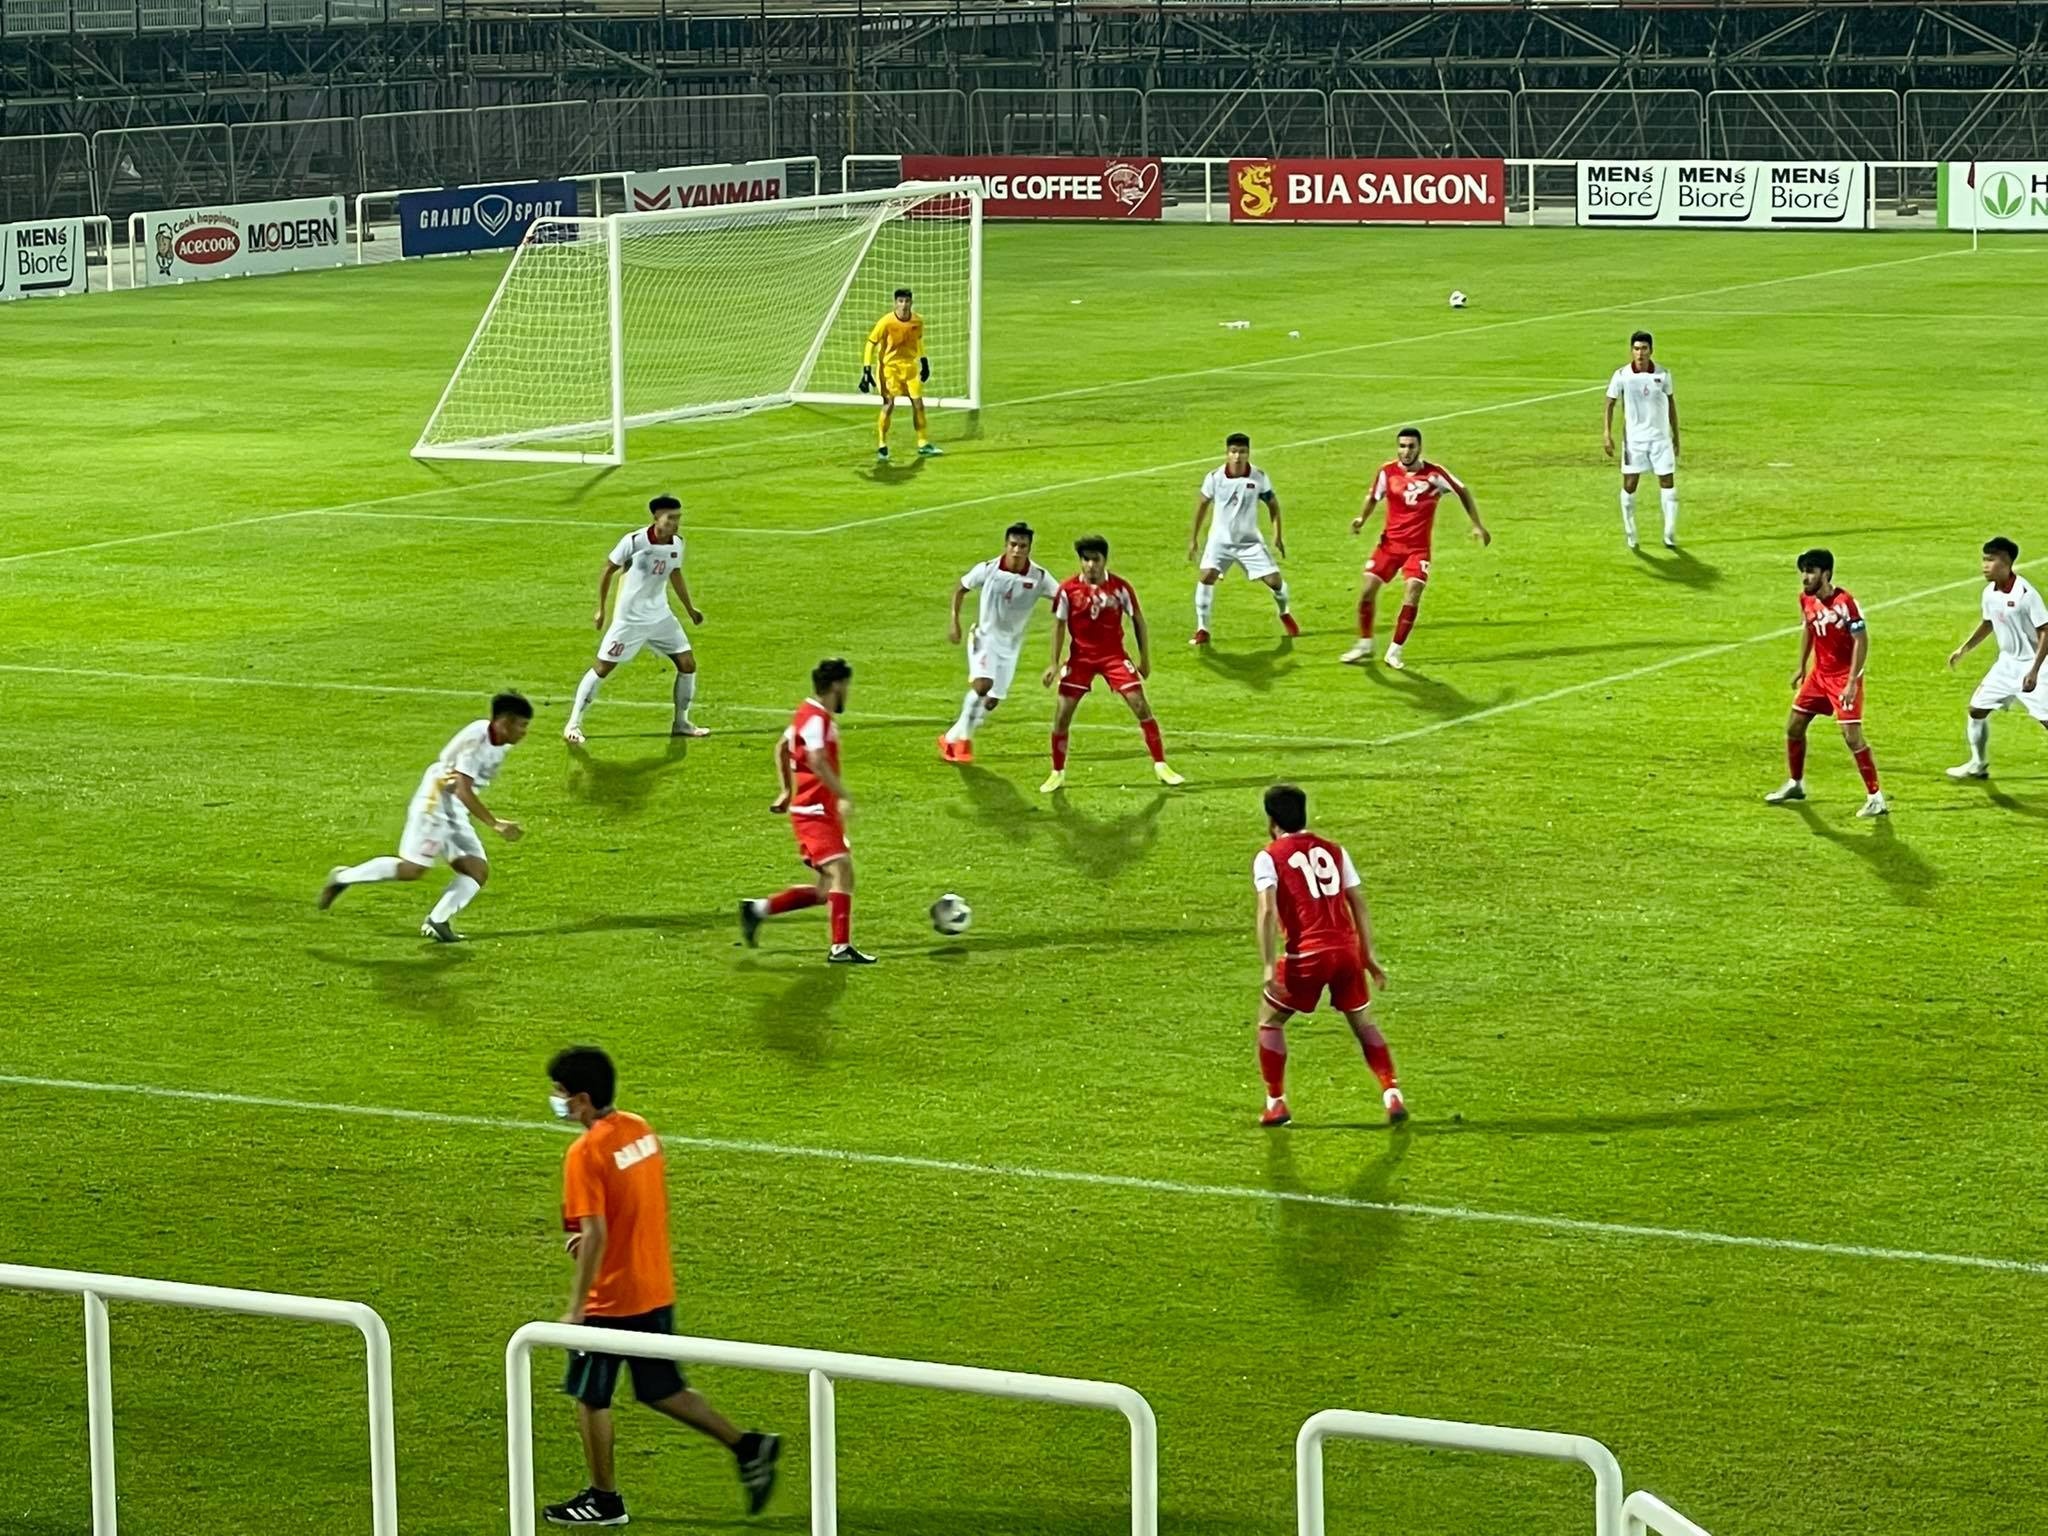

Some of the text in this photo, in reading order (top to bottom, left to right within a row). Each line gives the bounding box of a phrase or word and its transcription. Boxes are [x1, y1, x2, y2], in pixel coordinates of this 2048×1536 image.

[677, 178, 780, 208] YANMAR
[1011, 175, 1102, 200] COFFEE
[1288, 173, 1488, 205] BIA SAIGON
[1588, 184, 1653, 207] Bioré
[1678, 185, 1745, 208] Bioré
[1771, 185, 1839, 209] Bioré
[420, 200, 562, 229] GRAND SPORT
[248, 217, 338, 252] MODERN
[18, 247, 68, 275] Bioré
[652, 559, 666, 575] 20
[607, 640, 624, 656] 20
[1287, 845, 1341, 899] 19
